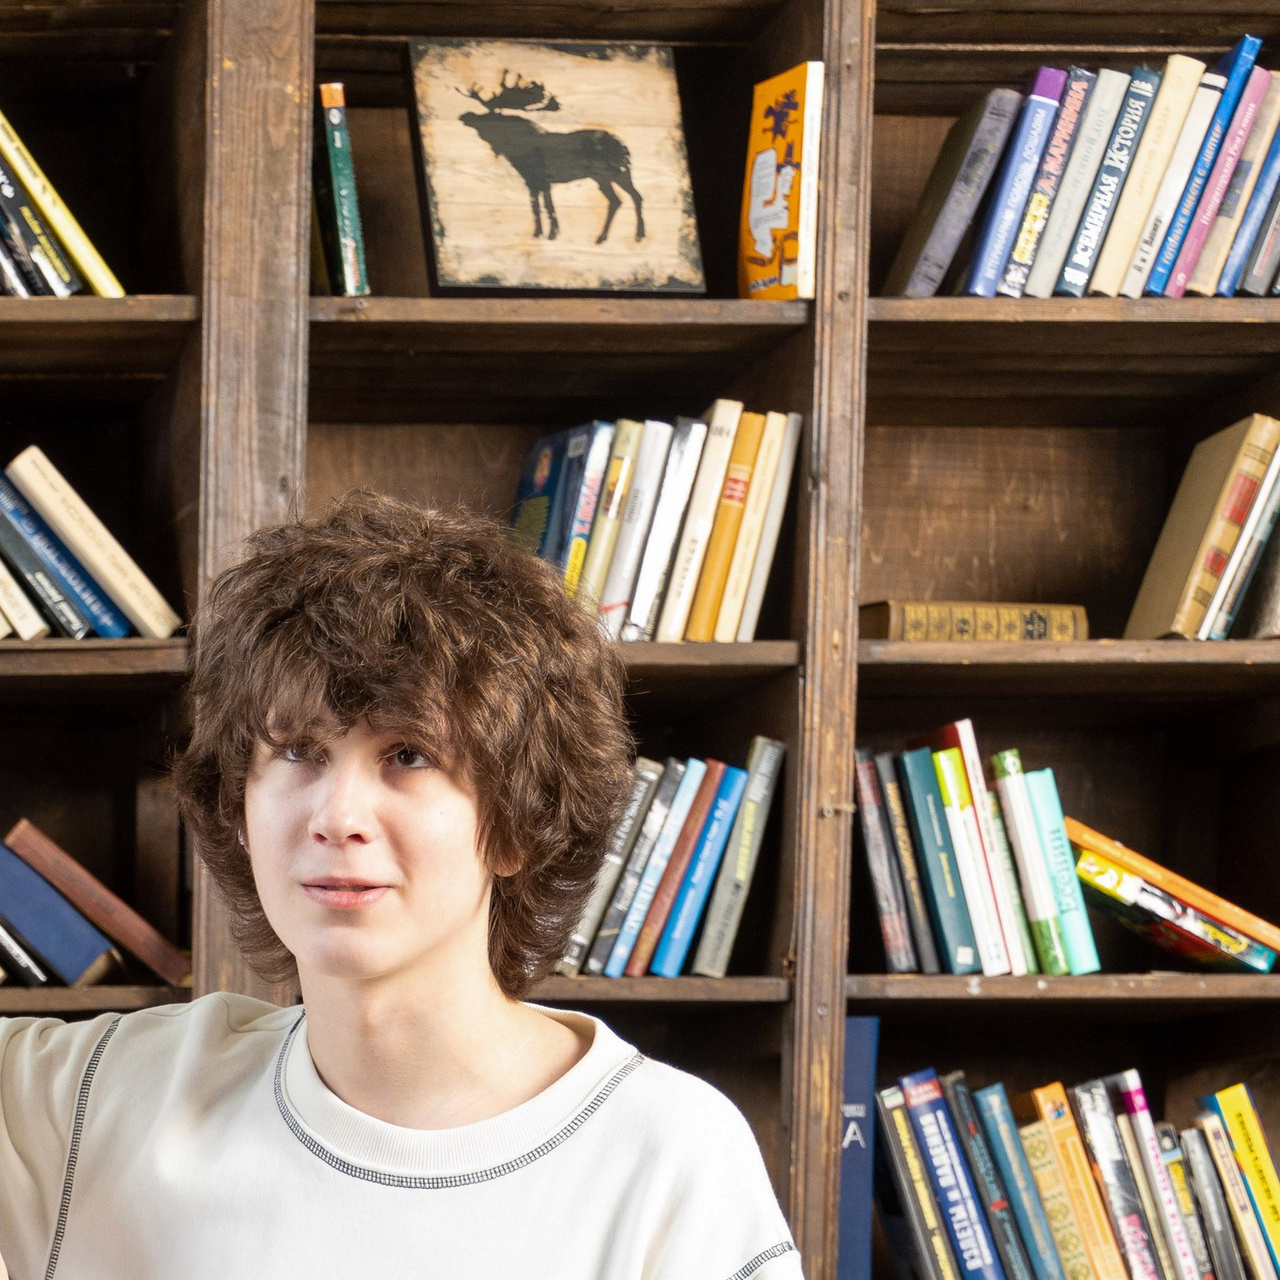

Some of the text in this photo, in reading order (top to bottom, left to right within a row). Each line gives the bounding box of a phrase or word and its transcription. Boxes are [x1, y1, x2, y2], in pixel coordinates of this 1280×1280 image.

[1020, 107, 1048, 160] ЛОШАДЯМ
[1034, 76, 1090, 196] А. МАРИНИНА
[1069, 95, 1147, 268] ВСЕМИРНАЯ ИСТОРИЯ
[1160, 214, 1188, 265] ГОТОВЬТЕ
[1178, 174, 1204, 216] ВМЕСТЕ
[1197, 153, 1236, 227] Императорский
[1225, 133, 1243, 156] Рим
[1040, 825, 1079, 916] Есенин
[842, 1121, 866, 1149] А
[916, 1110, 957, 1189] ПАДЕНИЯ
[946, 1202, 984, 1271] ВЗЛЕТЫ
